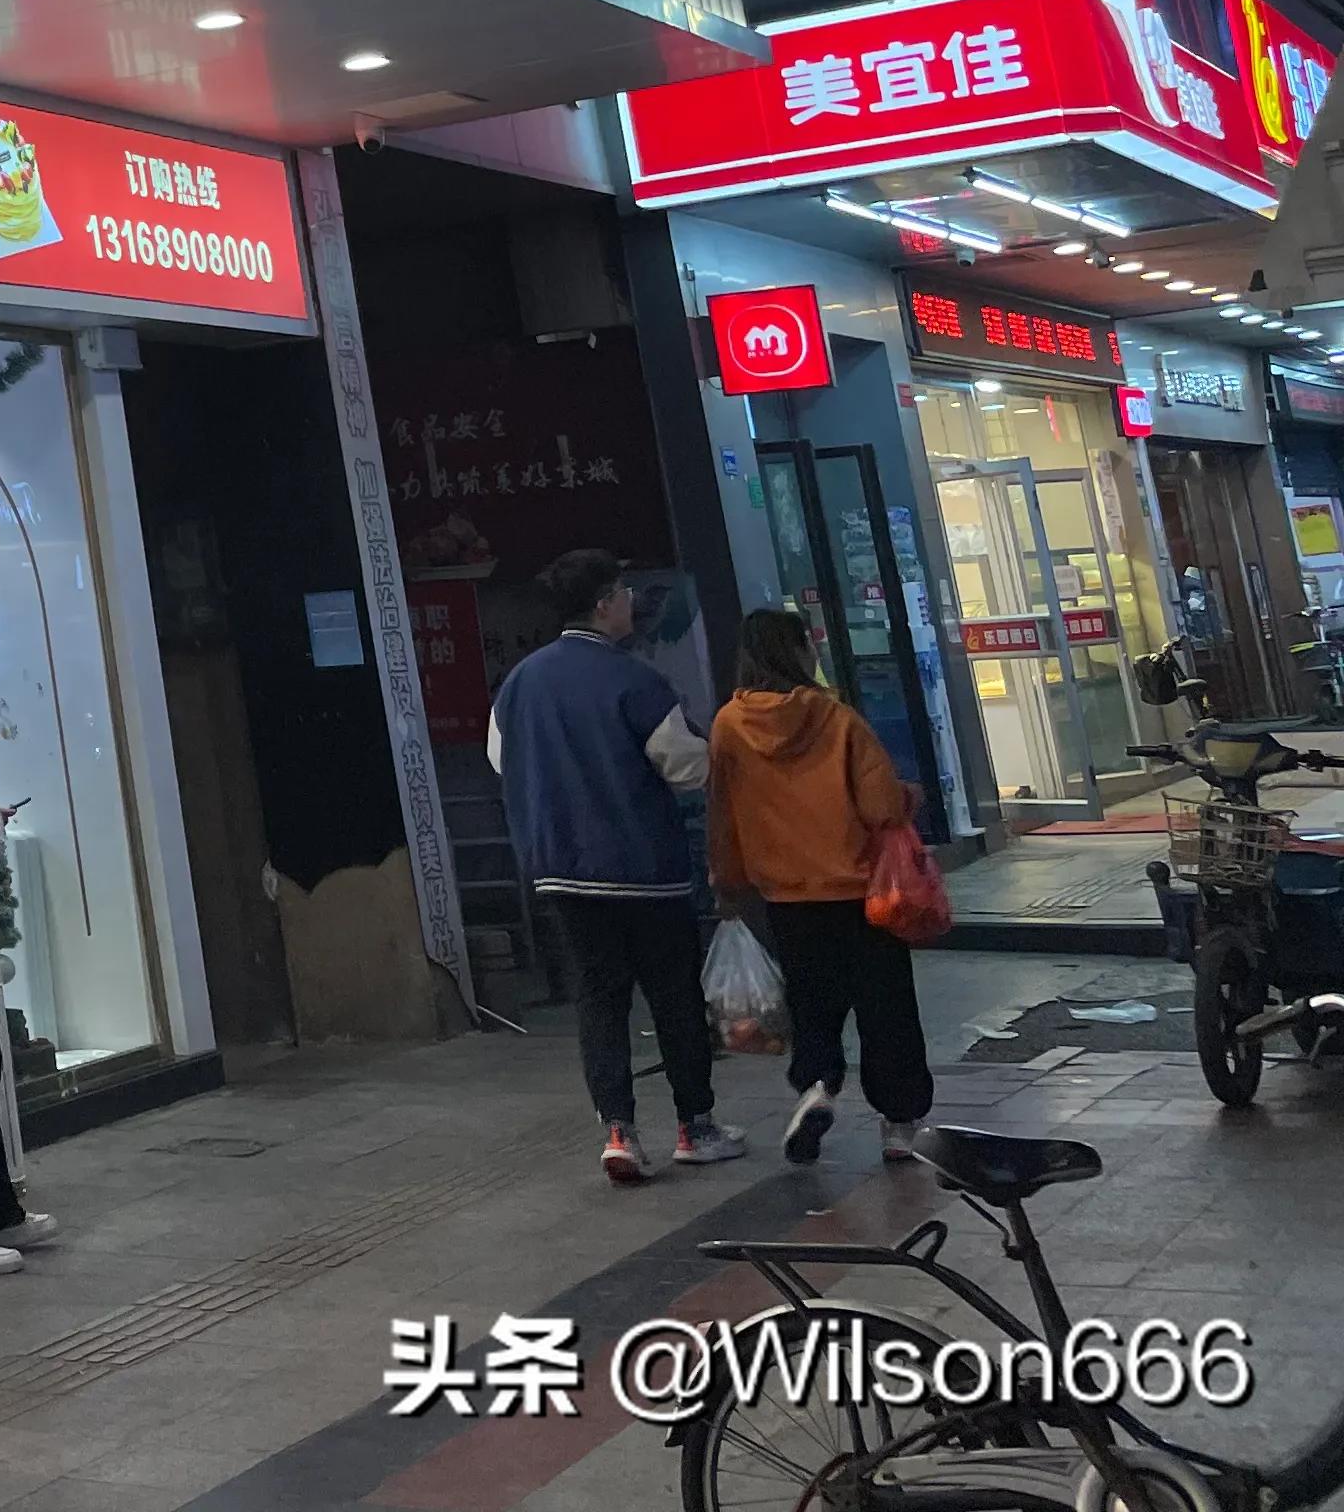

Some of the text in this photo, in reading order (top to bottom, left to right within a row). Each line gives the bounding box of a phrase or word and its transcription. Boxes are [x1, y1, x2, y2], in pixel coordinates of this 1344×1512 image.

[781, 25, 1031, 126] 美宜佳
[125, 150, 220, 210] 订购热线
[86, 214, 273, 283] 13168908000
[402, 739, 461, 977] 共筑美好社
